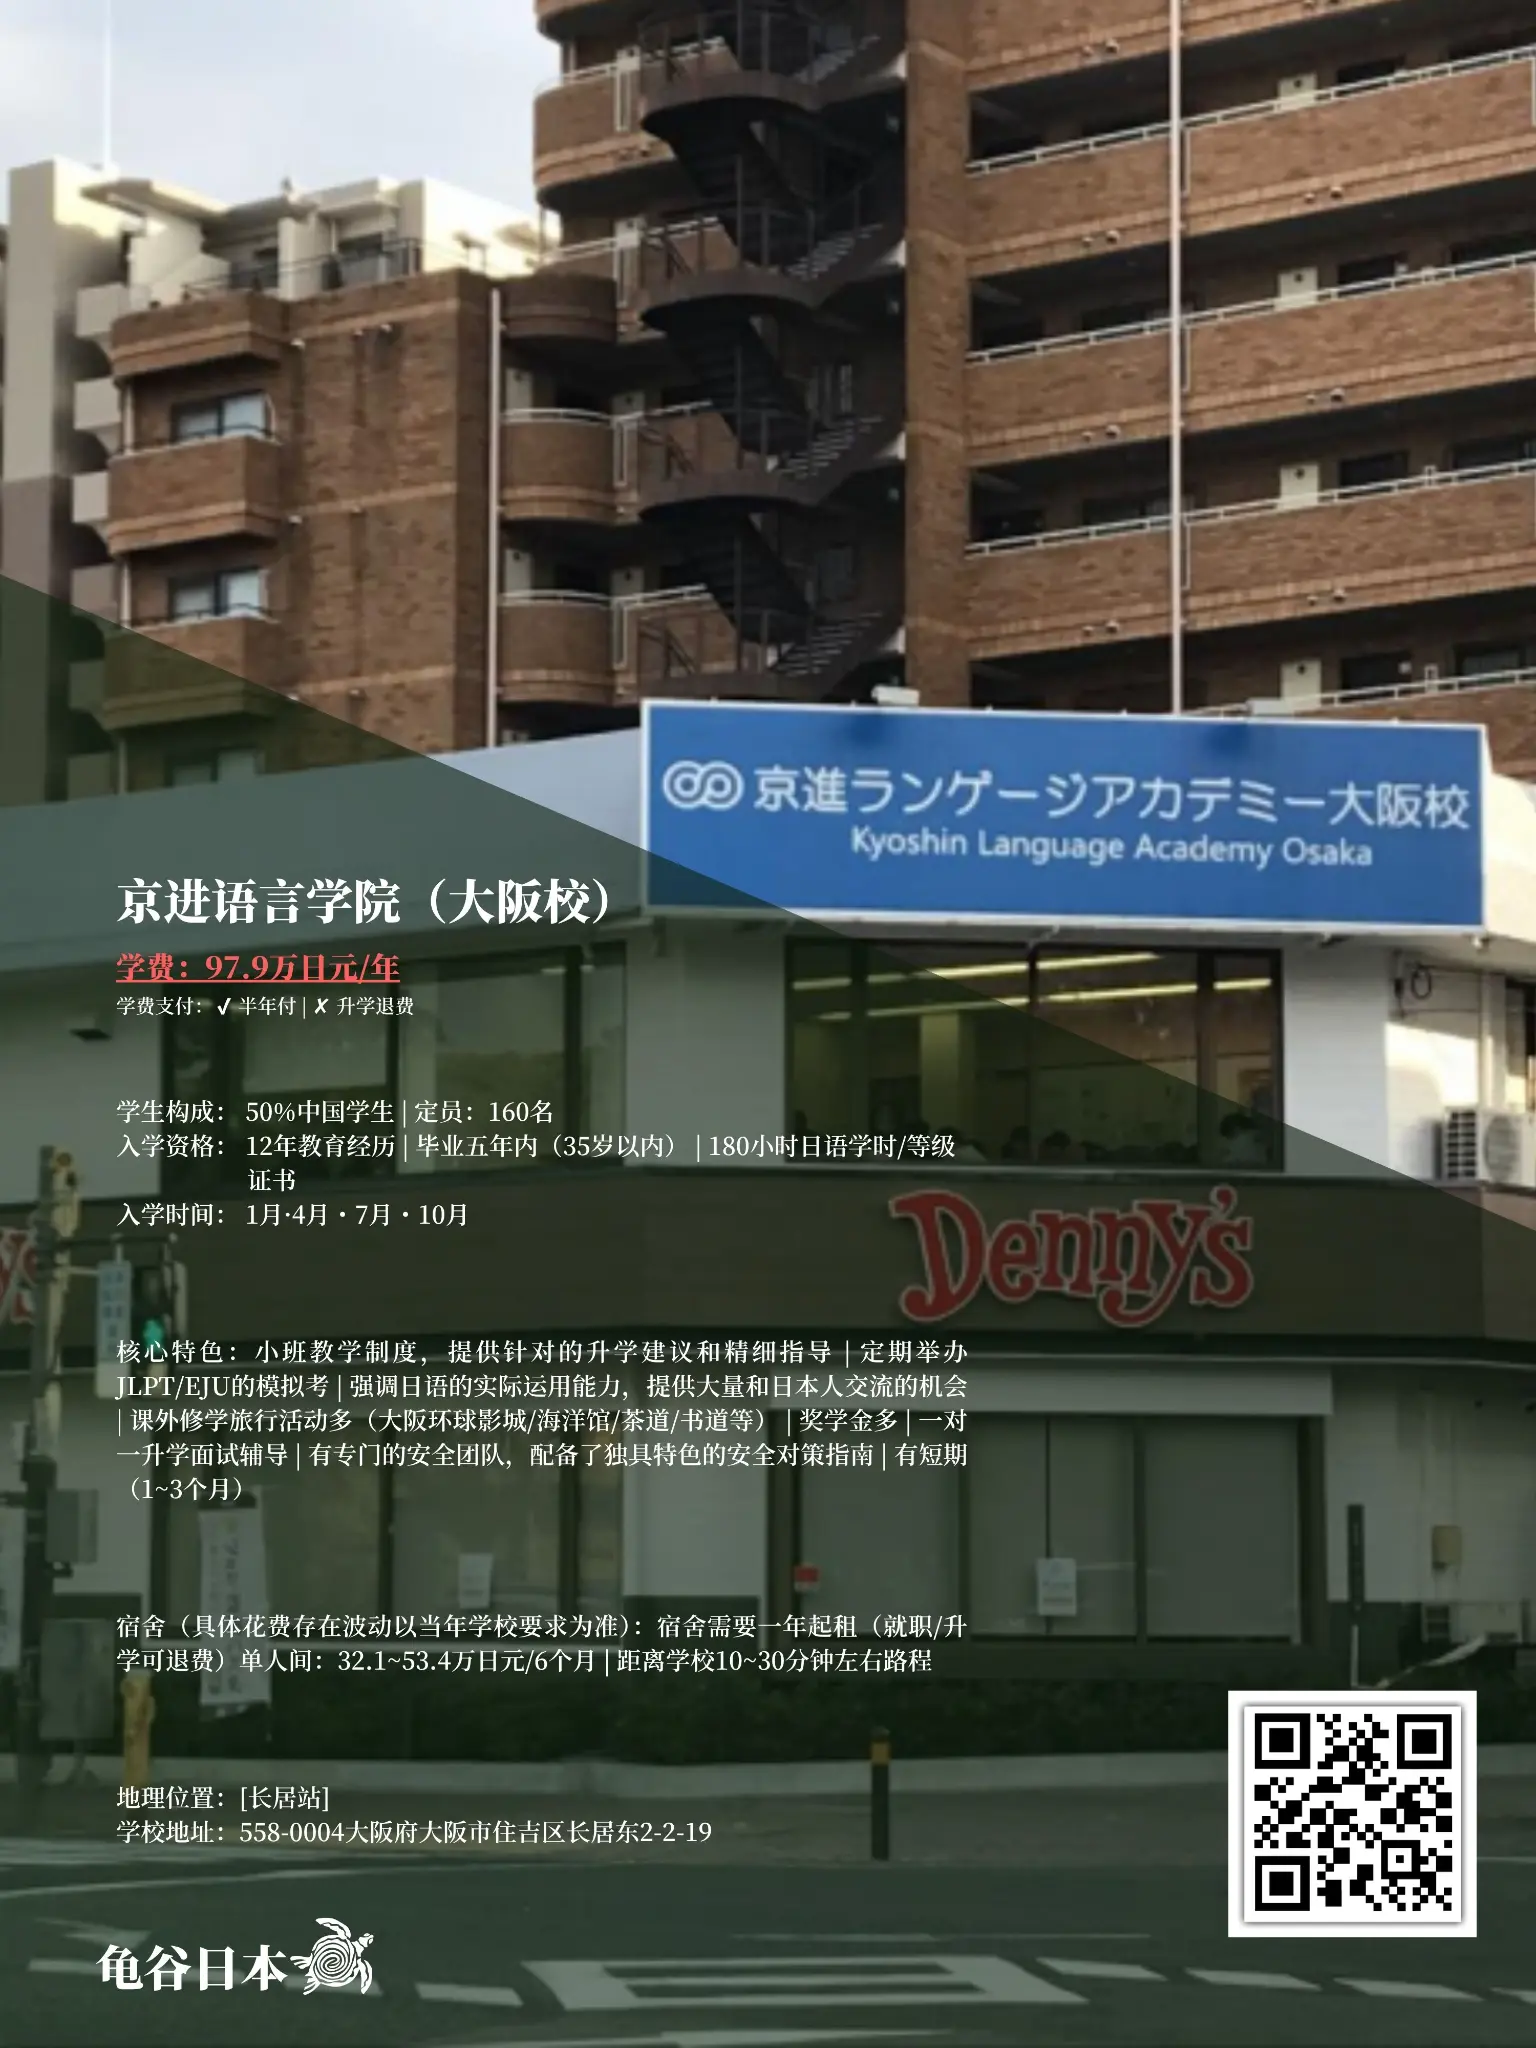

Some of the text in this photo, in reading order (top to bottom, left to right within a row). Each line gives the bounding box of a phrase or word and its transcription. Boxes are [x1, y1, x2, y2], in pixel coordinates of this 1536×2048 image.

[754, 764, 1470, 829] 京進ランゲージアカデミー大阪校
[851, 825, 1373, 871] Kyoshin Language Academy Osaka
[888, 1184, 1253, 1328] Denny's
